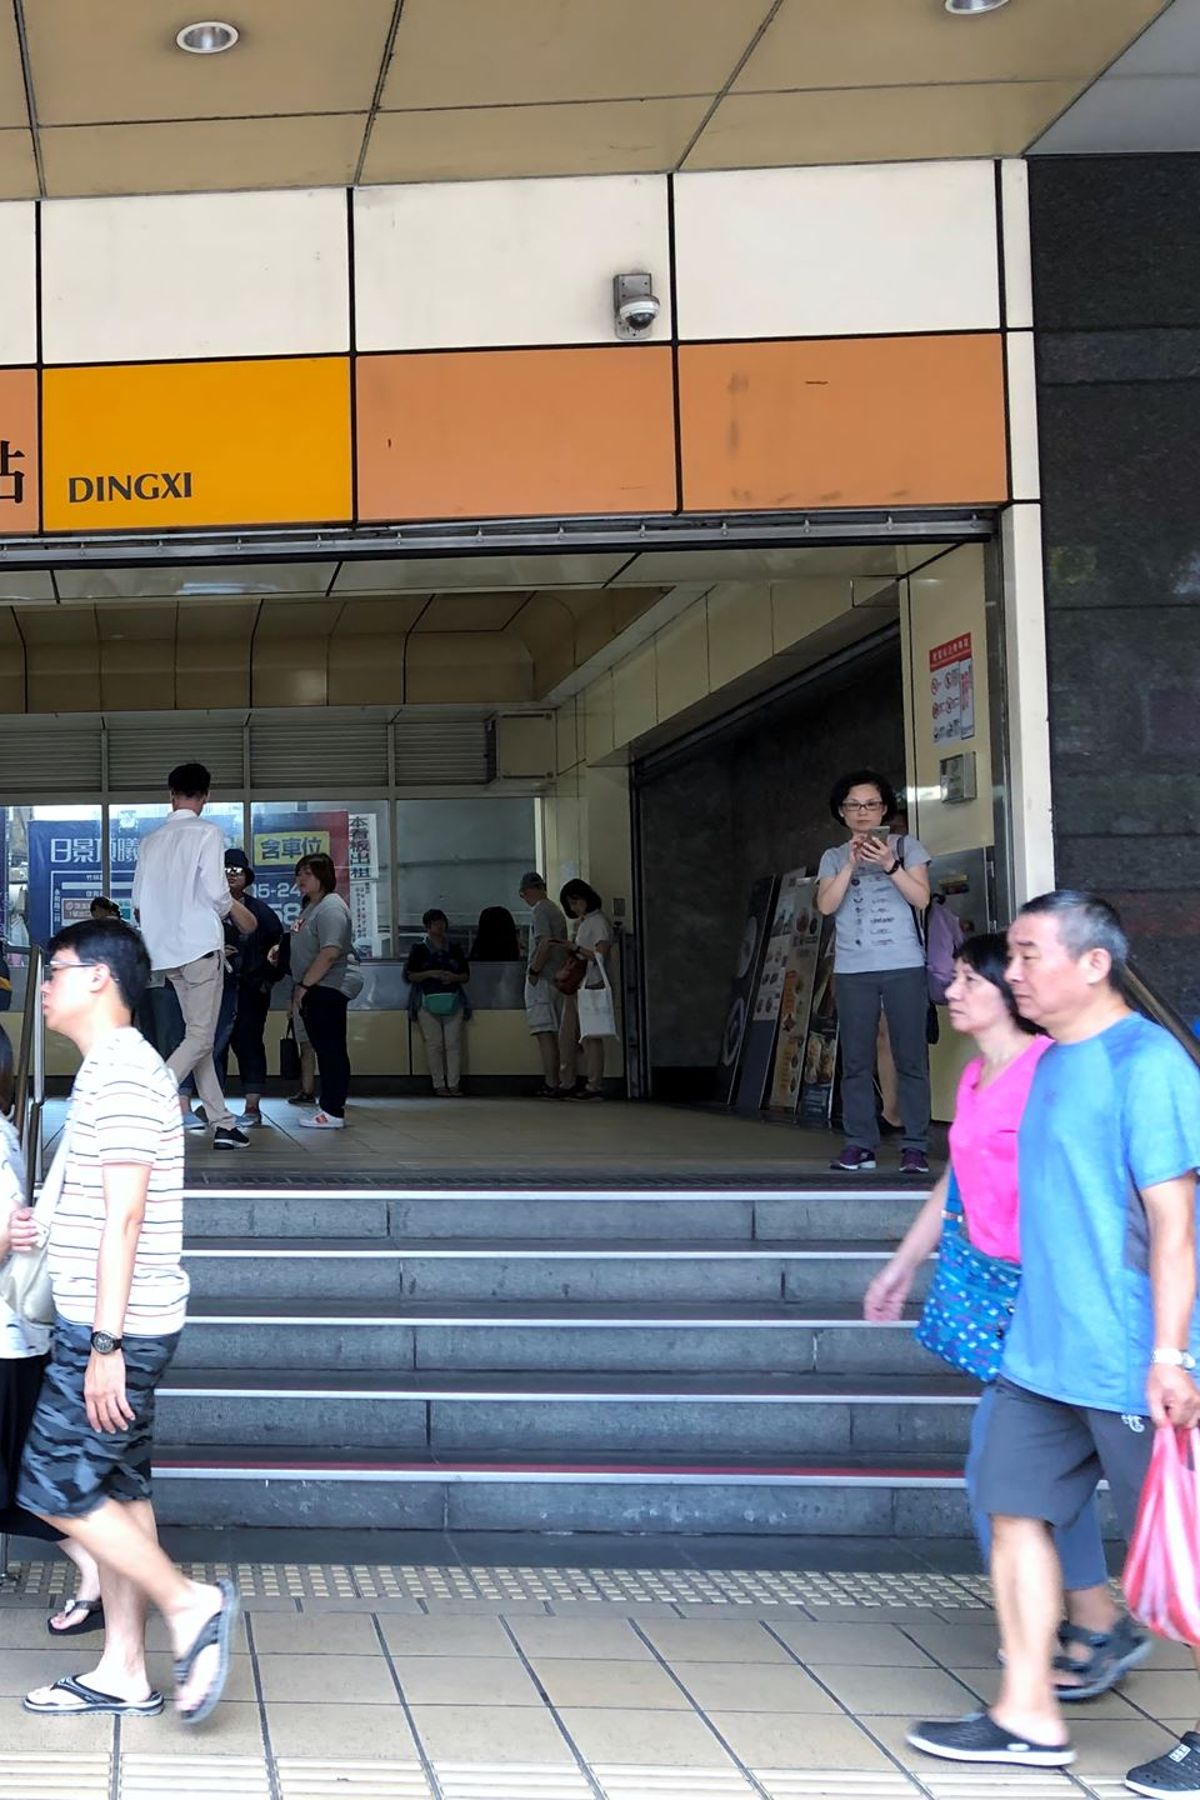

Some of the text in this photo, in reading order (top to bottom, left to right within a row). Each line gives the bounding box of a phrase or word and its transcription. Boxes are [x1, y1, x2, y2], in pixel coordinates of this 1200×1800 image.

[68, 471, 192, 504] DINGXI
[260, 837, 323, 860] 含車位
[350, 816, 371, 878] 本看板出租
